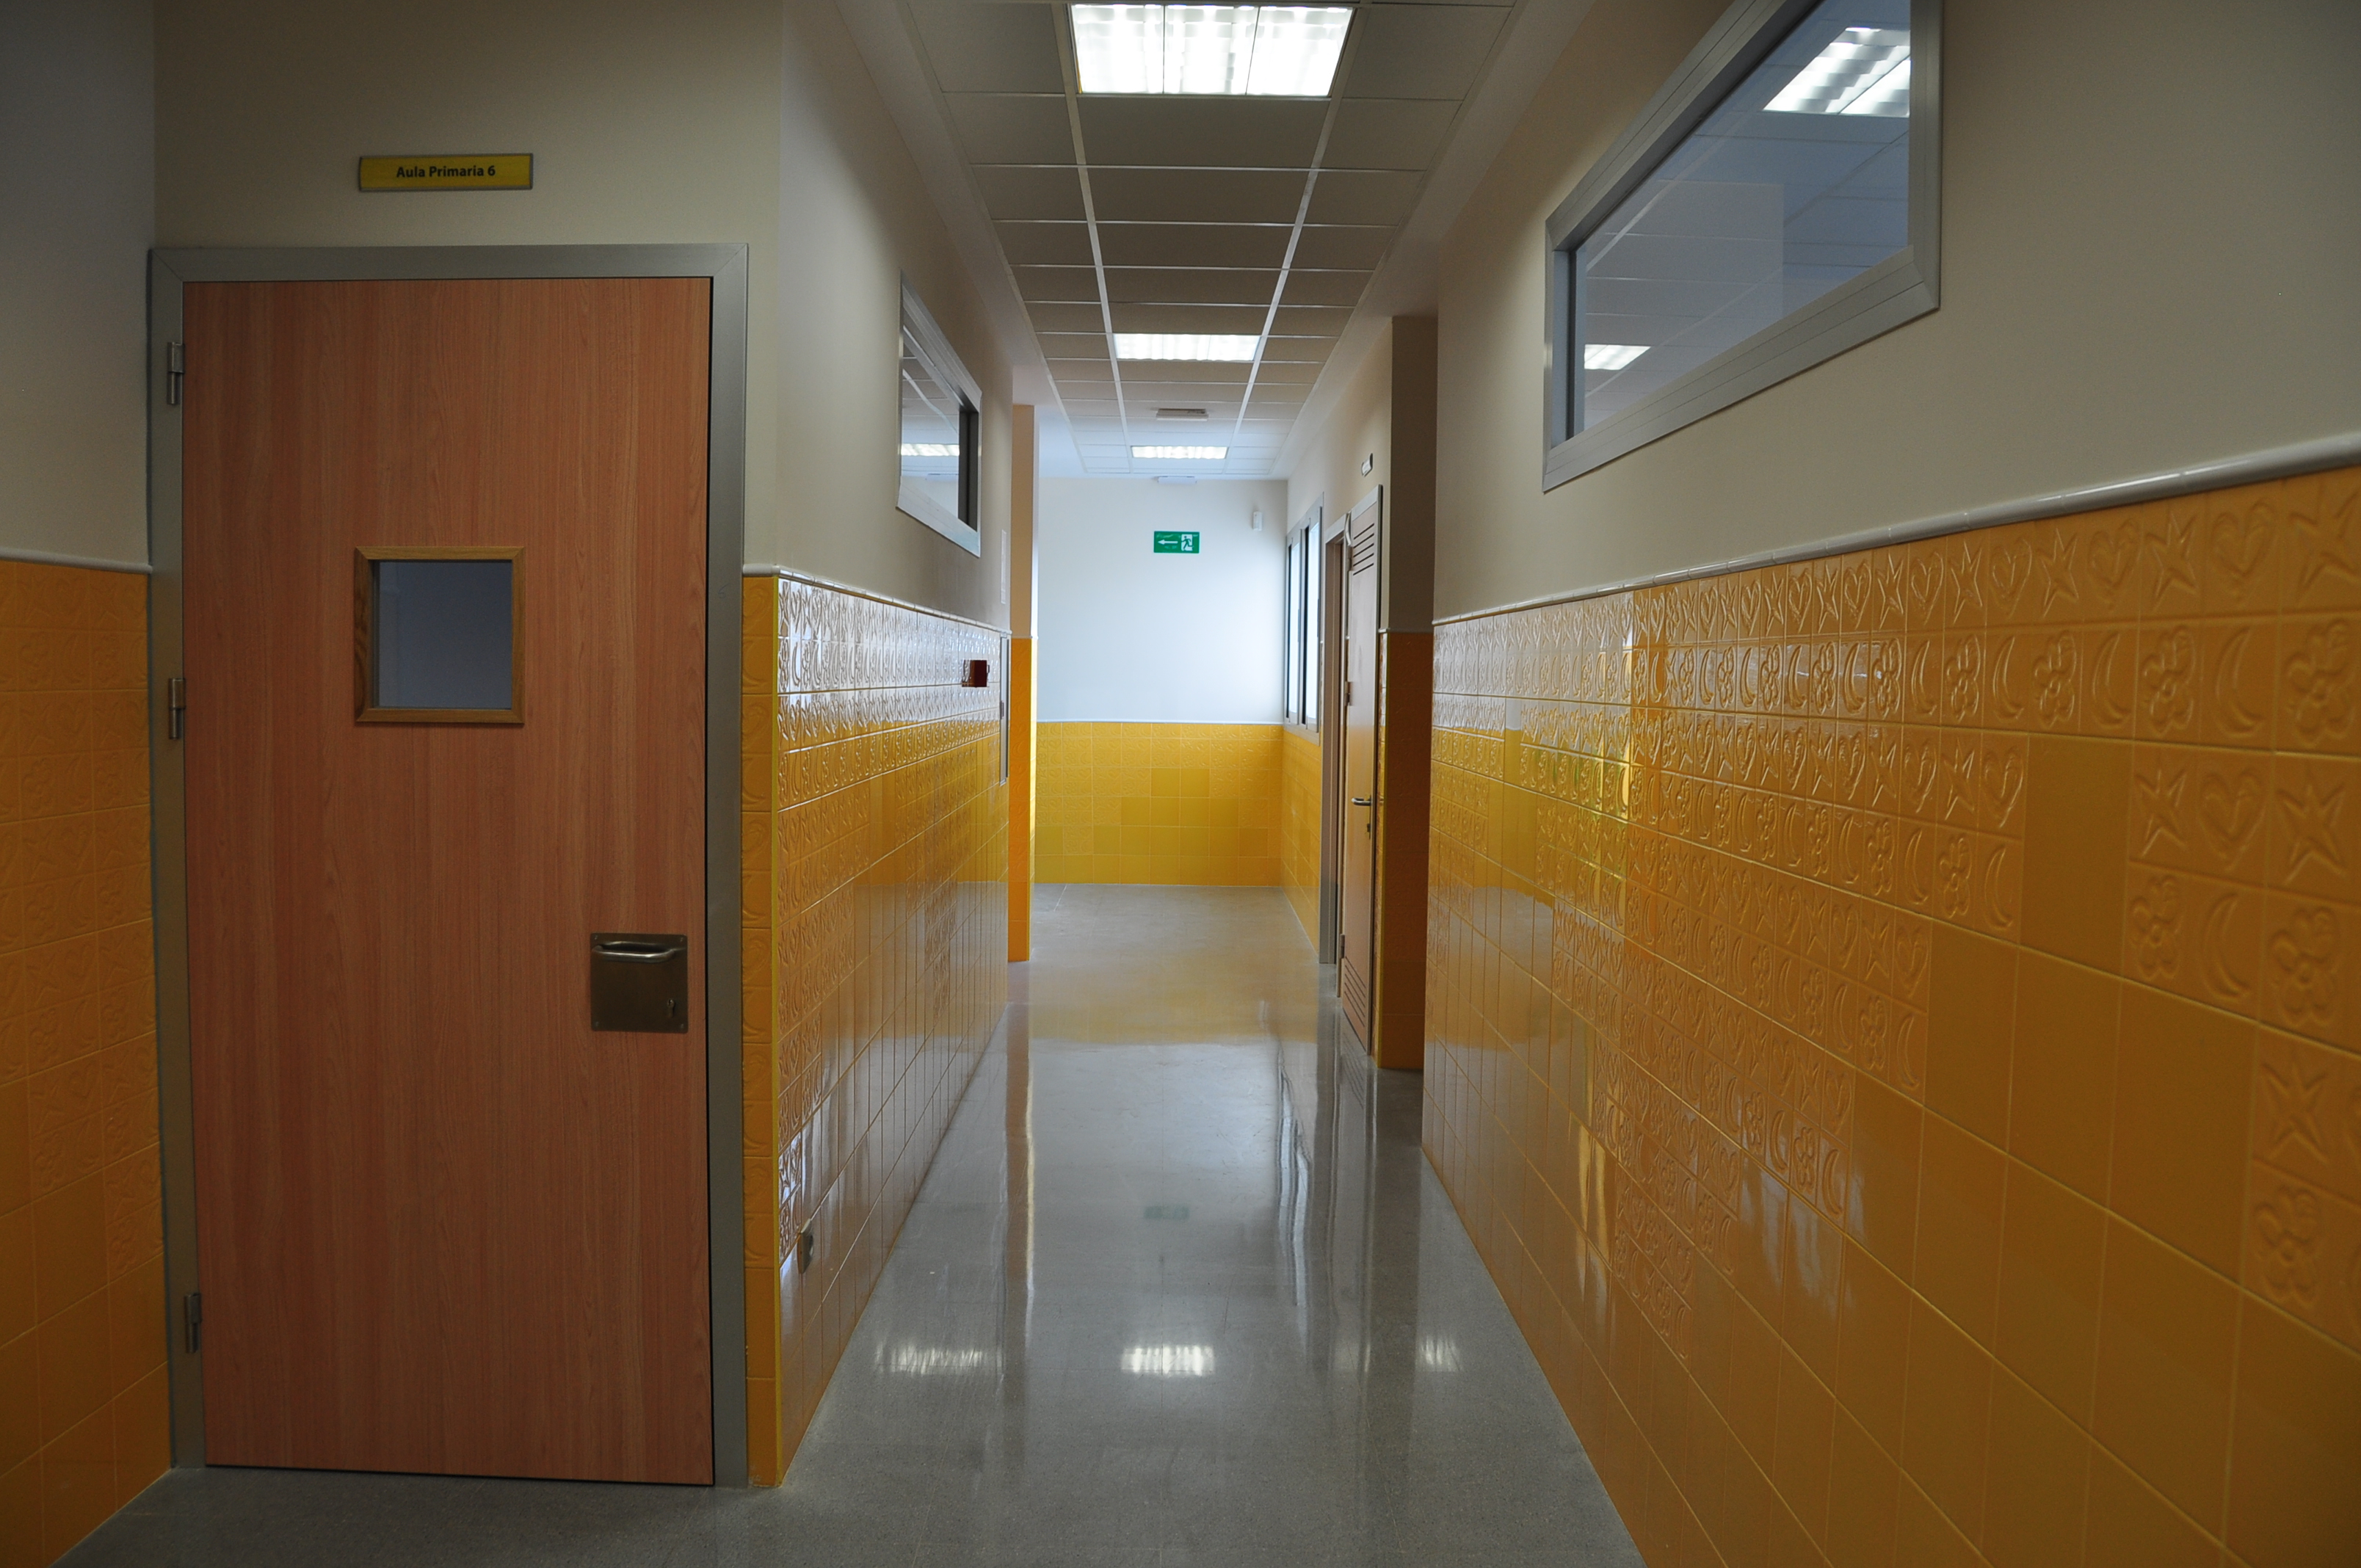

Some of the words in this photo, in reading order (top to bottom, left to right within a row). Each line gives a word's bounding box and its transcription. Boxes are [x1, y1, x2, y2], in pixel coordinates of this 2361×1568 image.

[396, 167, 425, 178] Aula
[429, 165, 484, 177] Primaria
[487, 165, 496, 176] 6
